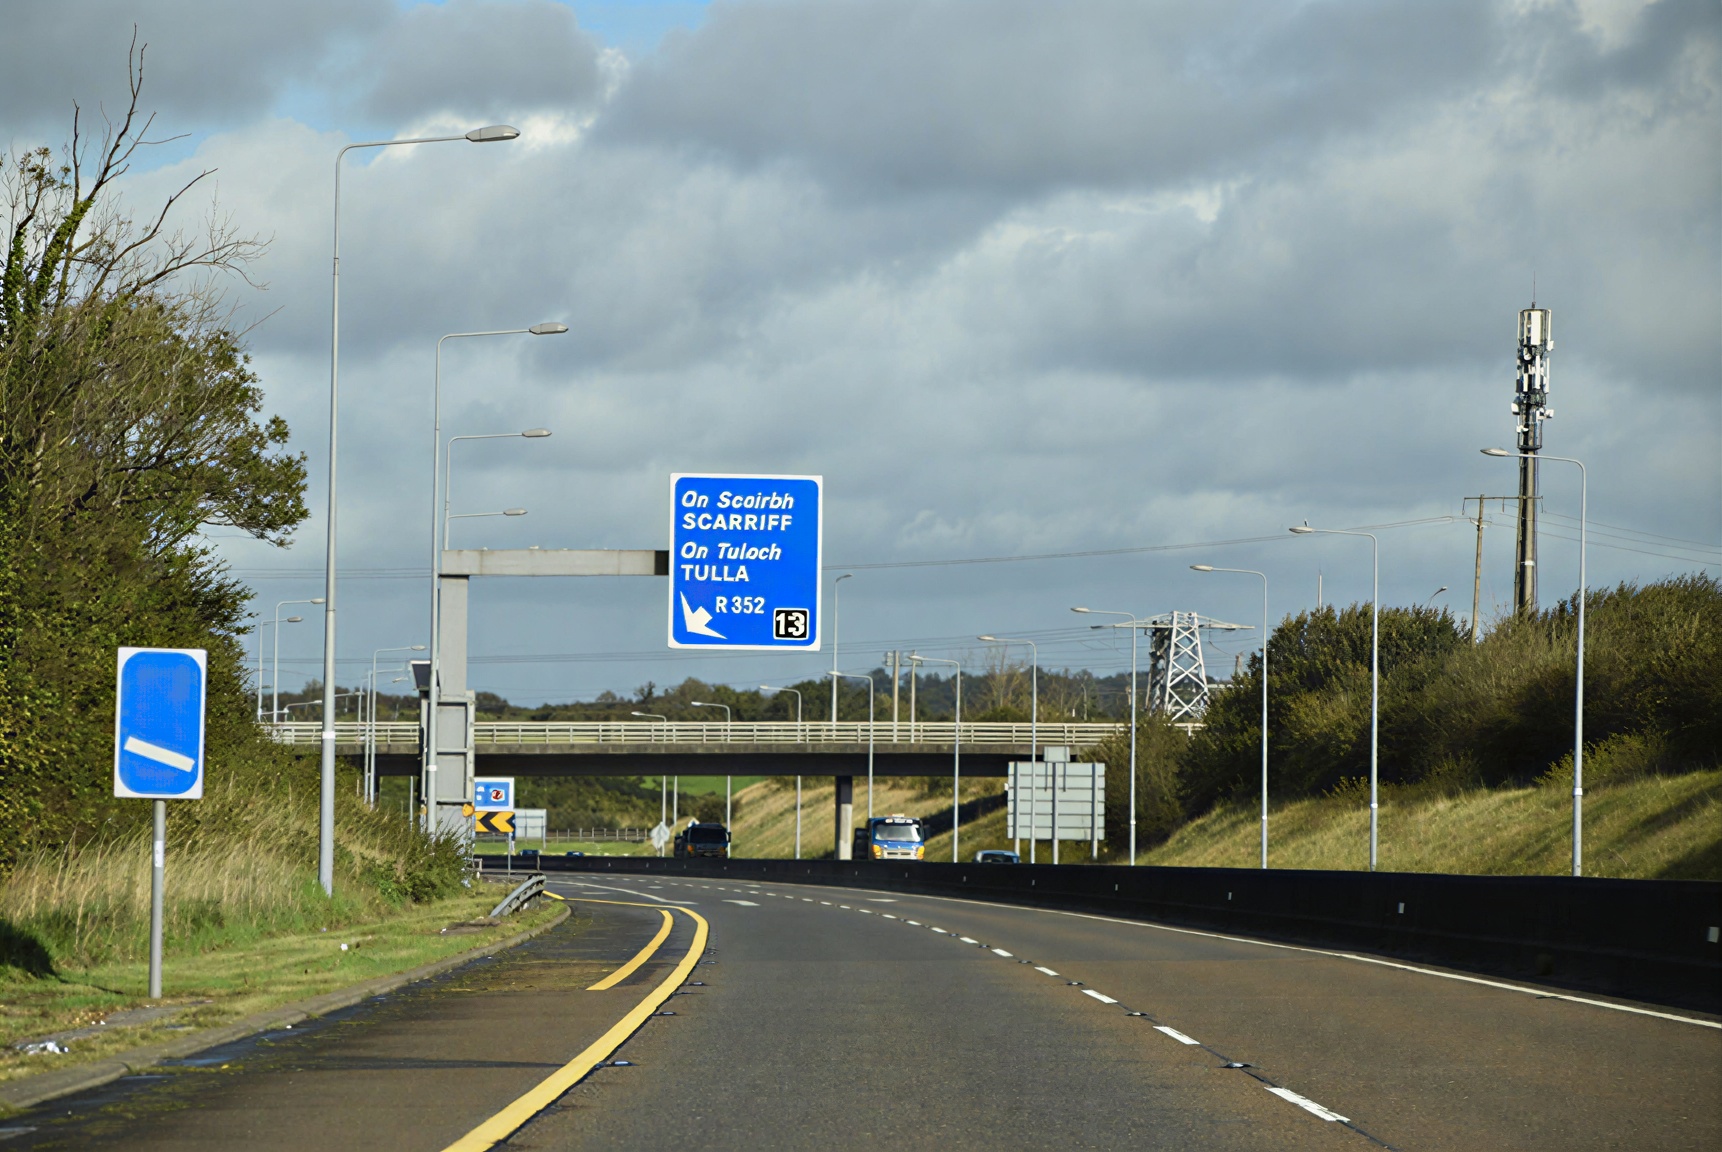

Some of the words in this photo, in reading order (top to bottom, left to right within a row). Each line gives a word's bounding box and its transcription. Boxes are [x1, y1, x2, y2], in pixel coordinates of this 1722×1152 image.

[682, 512, 793, 531] SCARRIFF
[680, 564, 750, 583] TULLA
[775, 612, 806, 637] 13
